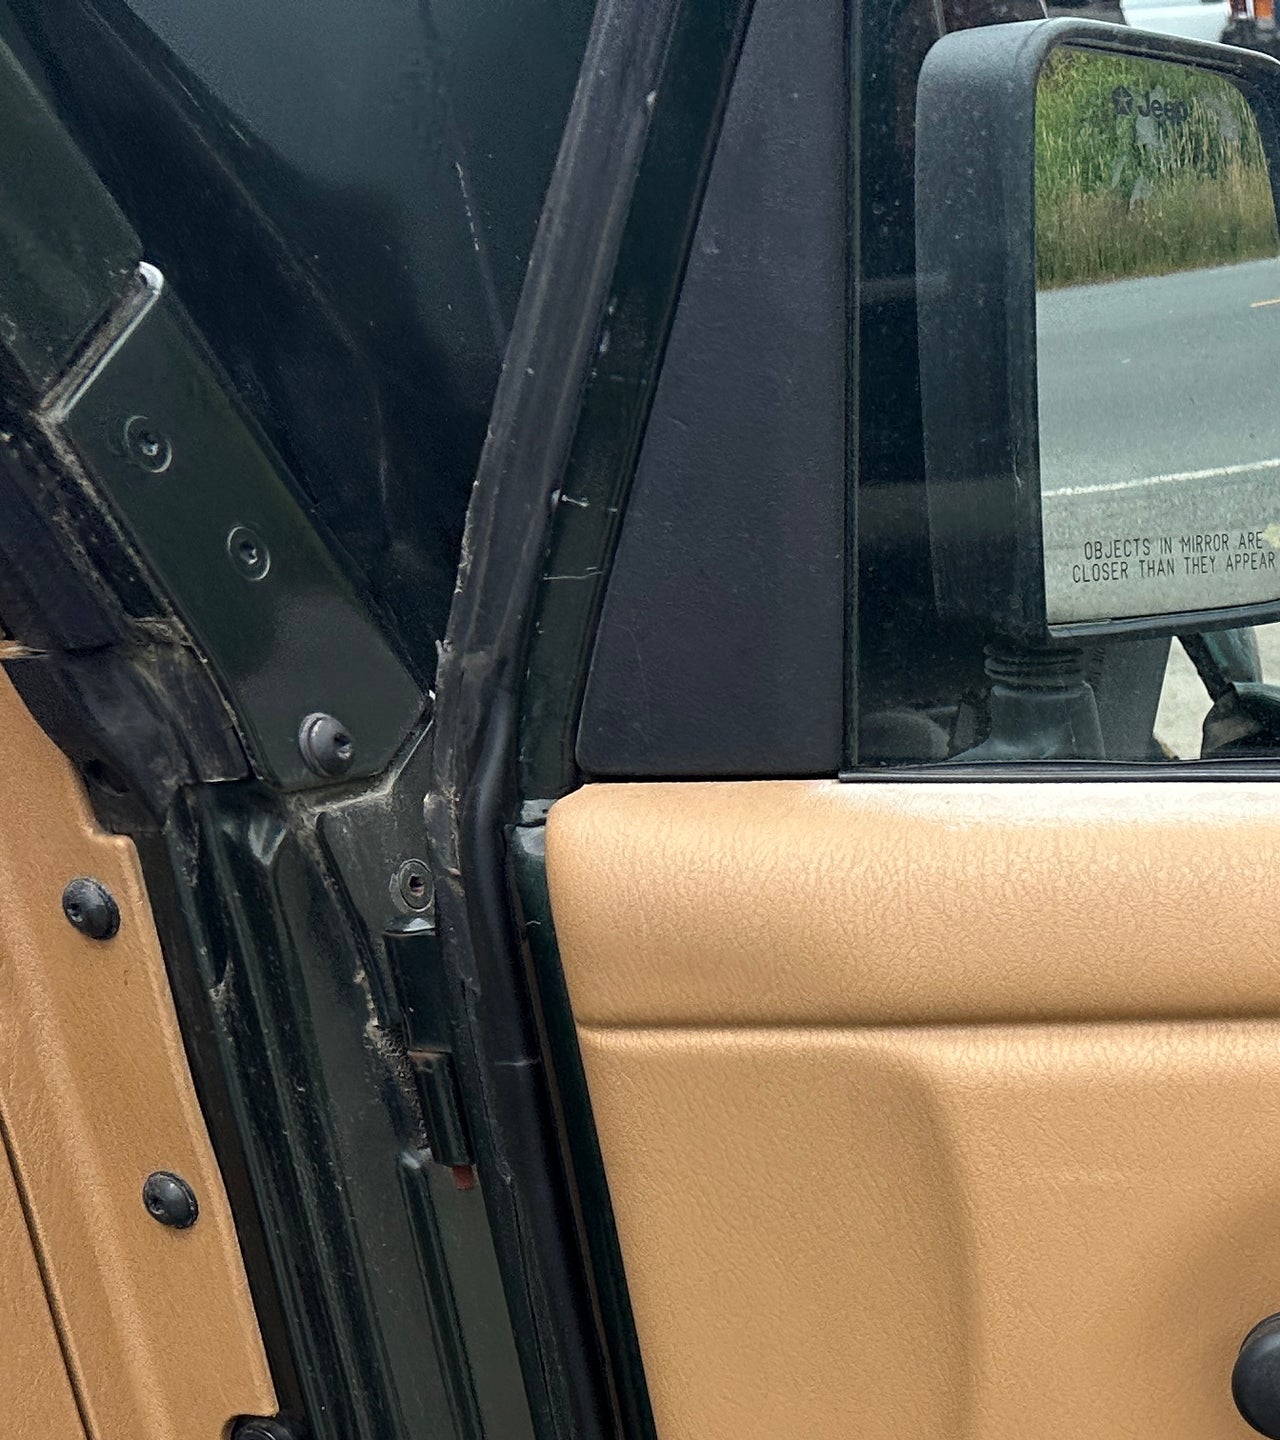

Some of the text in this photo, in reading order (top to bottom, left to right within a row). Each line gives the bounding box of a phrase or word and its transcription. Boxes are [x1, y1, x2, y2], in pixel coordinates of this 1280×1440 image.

[1138, 90, 1188, 123] Jeep
[1084, 531, 1263, 560] OBJECTS IN MIRROR ARE
[1072, 551, 1278, 583] CLOSER THAN THEY APPEAR
